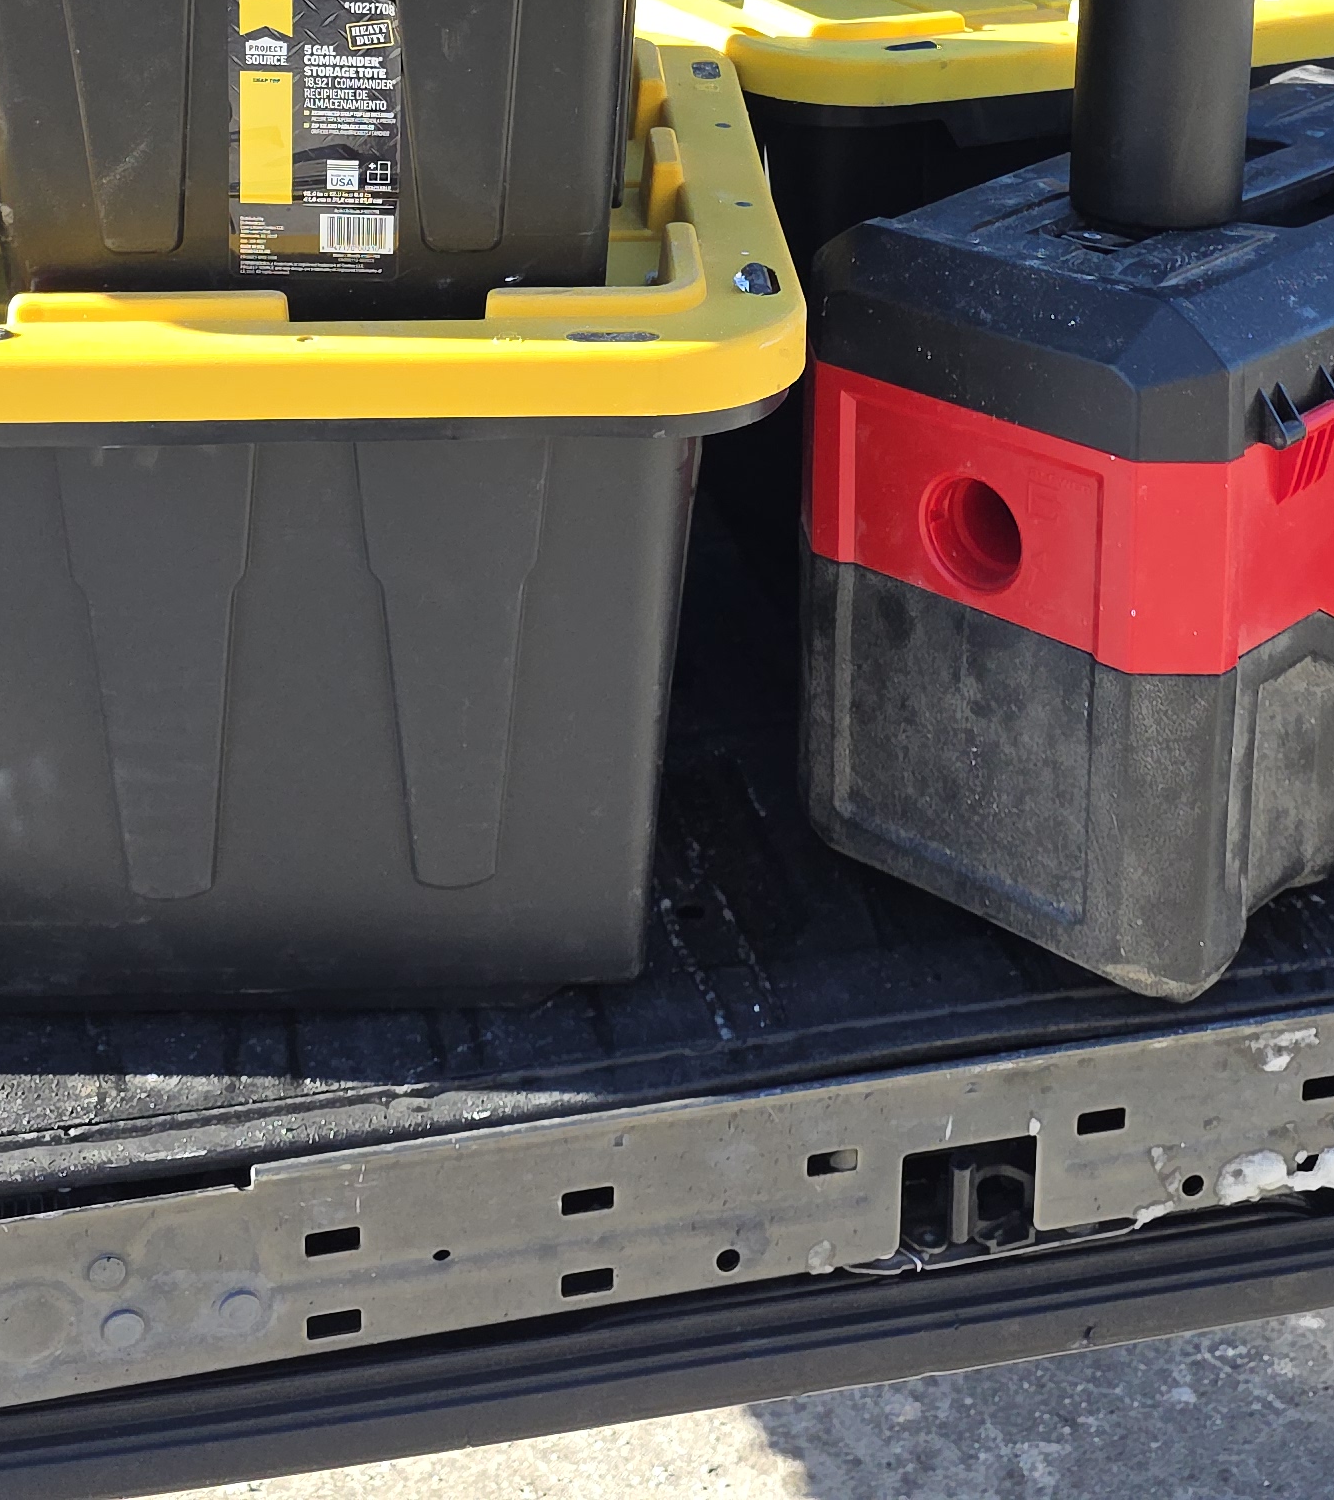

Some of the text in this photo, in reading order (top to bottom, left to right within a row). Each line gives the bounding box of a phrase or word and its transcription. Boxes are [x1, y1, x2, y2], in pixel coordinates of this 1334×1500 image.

[351, 23, 387, 36] HEAVY
[356, 33, 386, 45] DUTY
[248, 45, 283, 53] PROJECT
[304, 45, 336, 56] 5 GAL
[245, 55, 287, 65] SOURCE
[303, 66, 386, 78] STORAGE TOTE
[304, 77, 327, 88] 18,92
[304, 88, 369, 100] RECIPIENTE DE
[304, 98, 387, 110] ALMACENAMIENTO
[330, 178, 354, 187] USA
